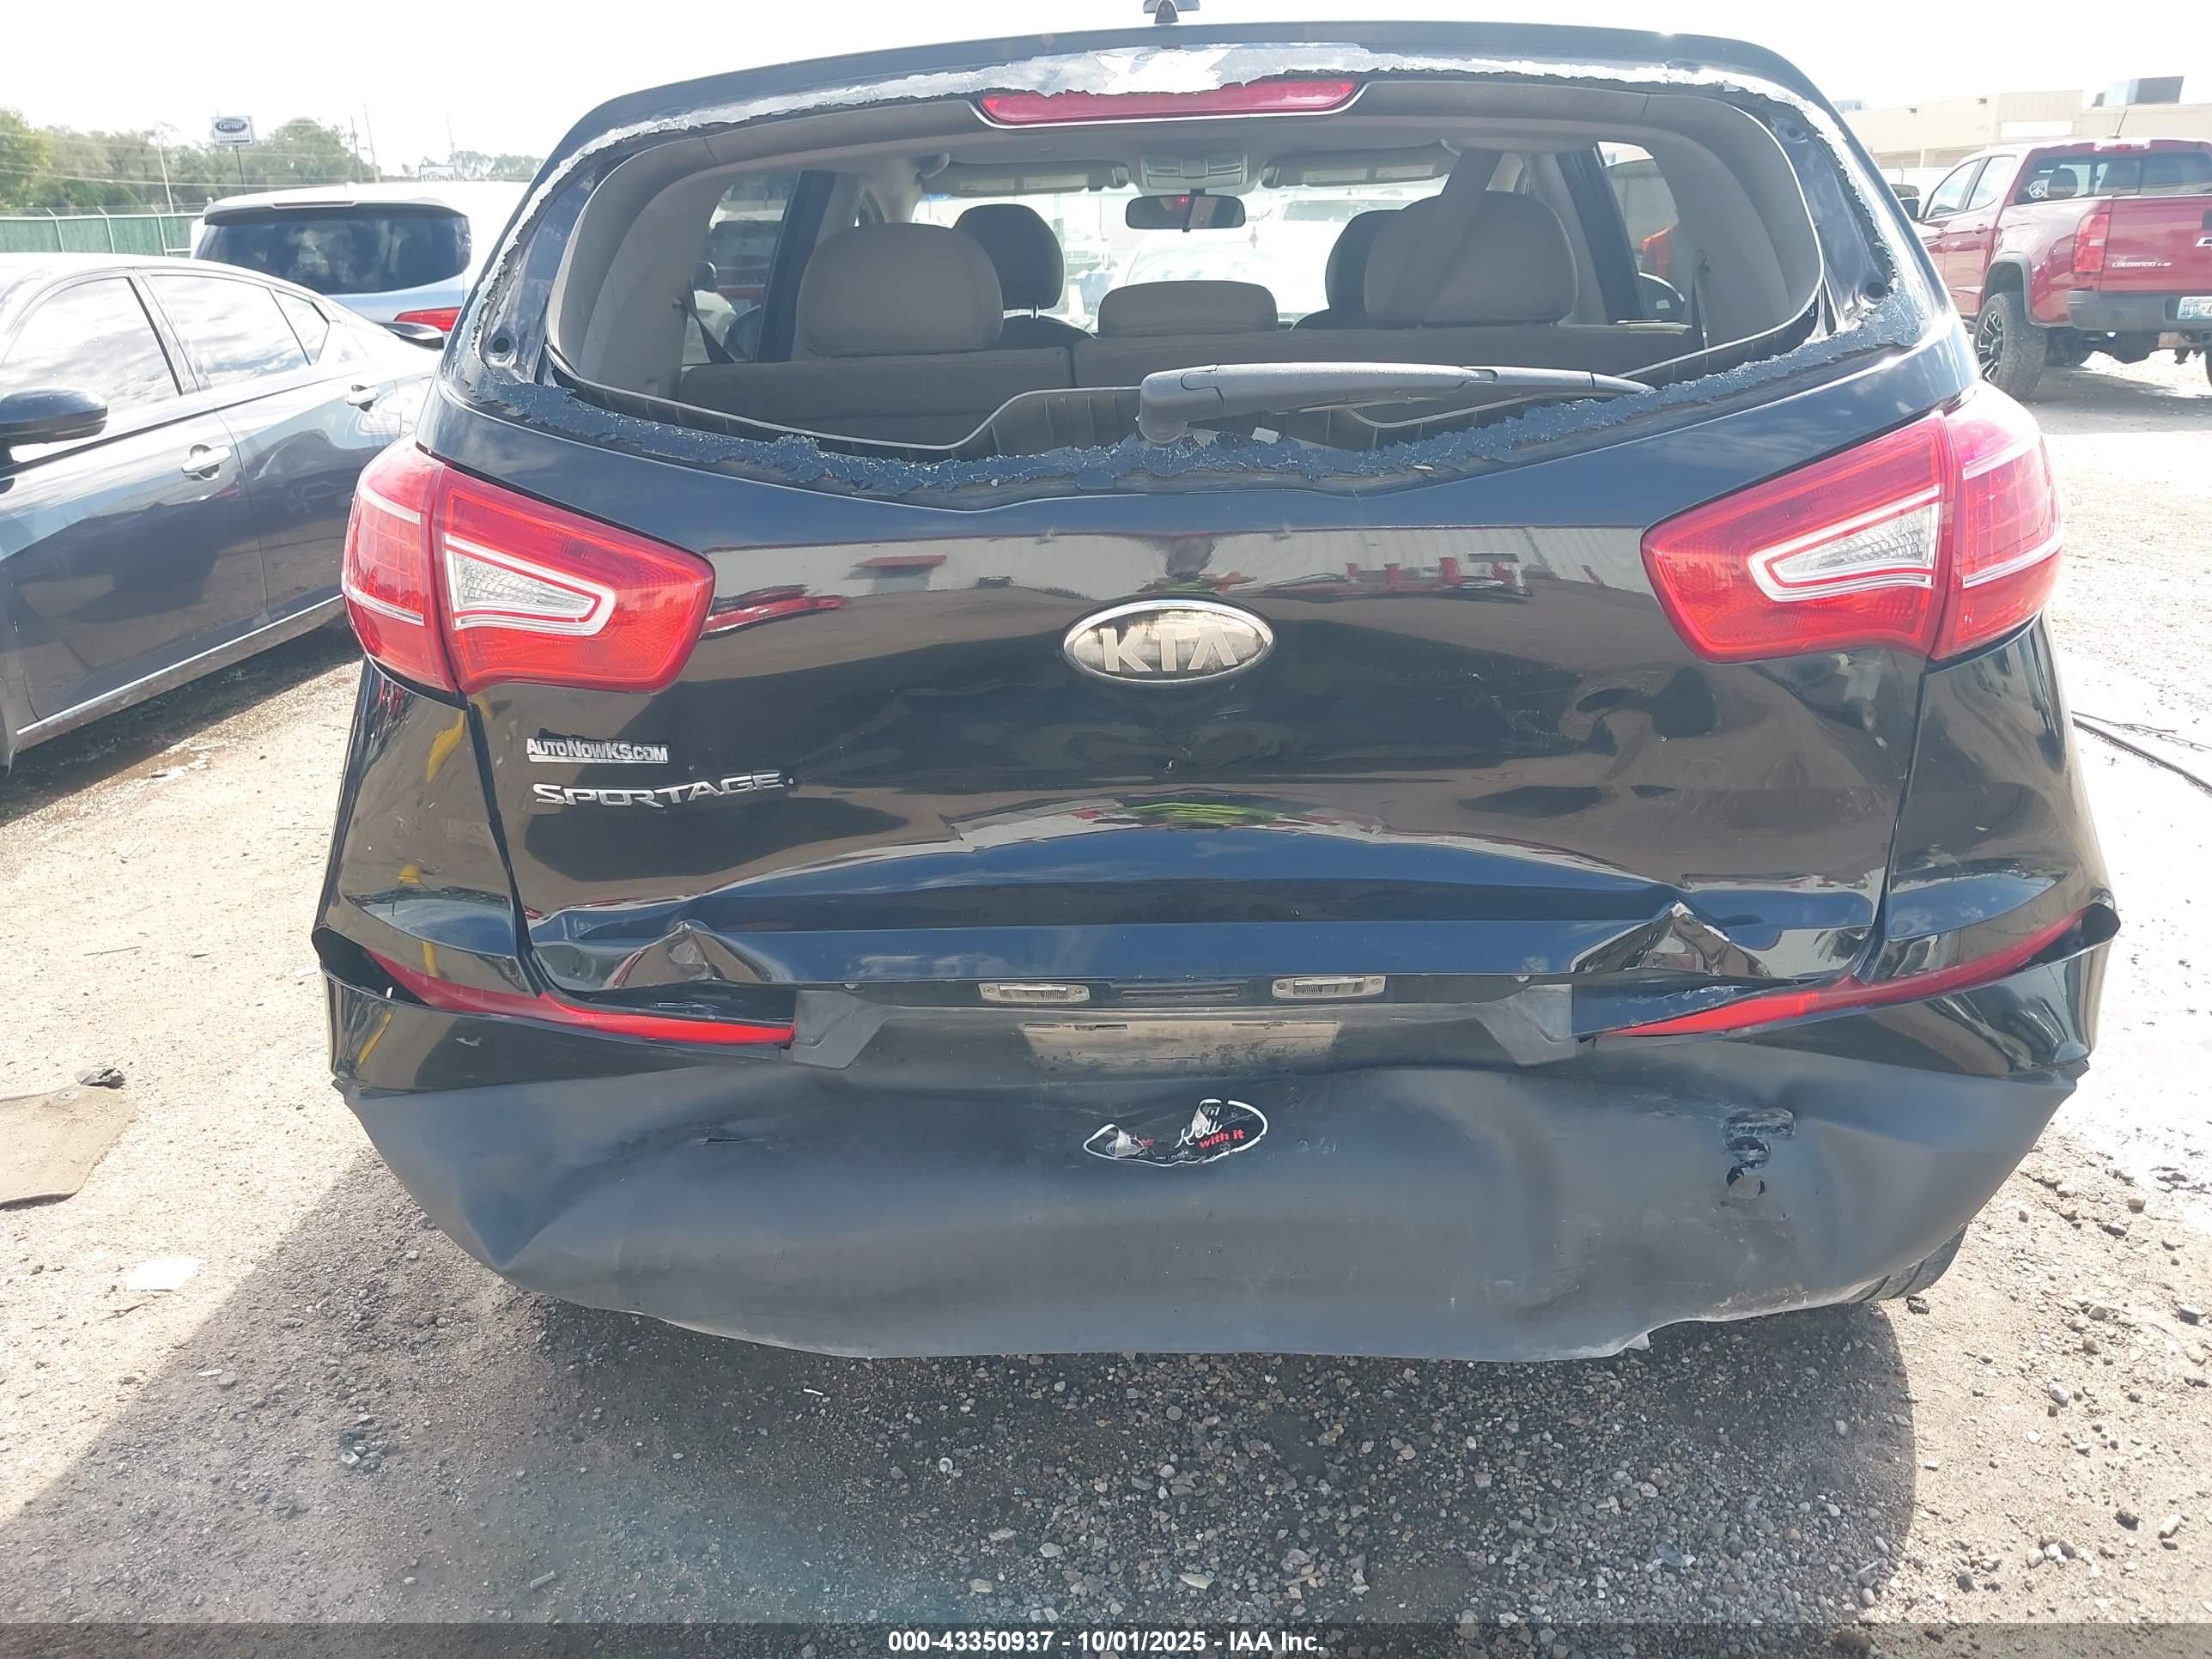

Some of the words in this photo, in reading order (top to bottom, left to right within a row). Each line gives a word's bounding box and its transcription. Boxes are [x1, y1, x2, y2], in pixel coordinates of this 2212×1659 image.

[1099, 627, 1238, 673] KIA
[532, 772, 786, 808] SPORTAGE
[1199, 1132, 1230, 1148] with
[1233, 1128, 1245, 1140] it
